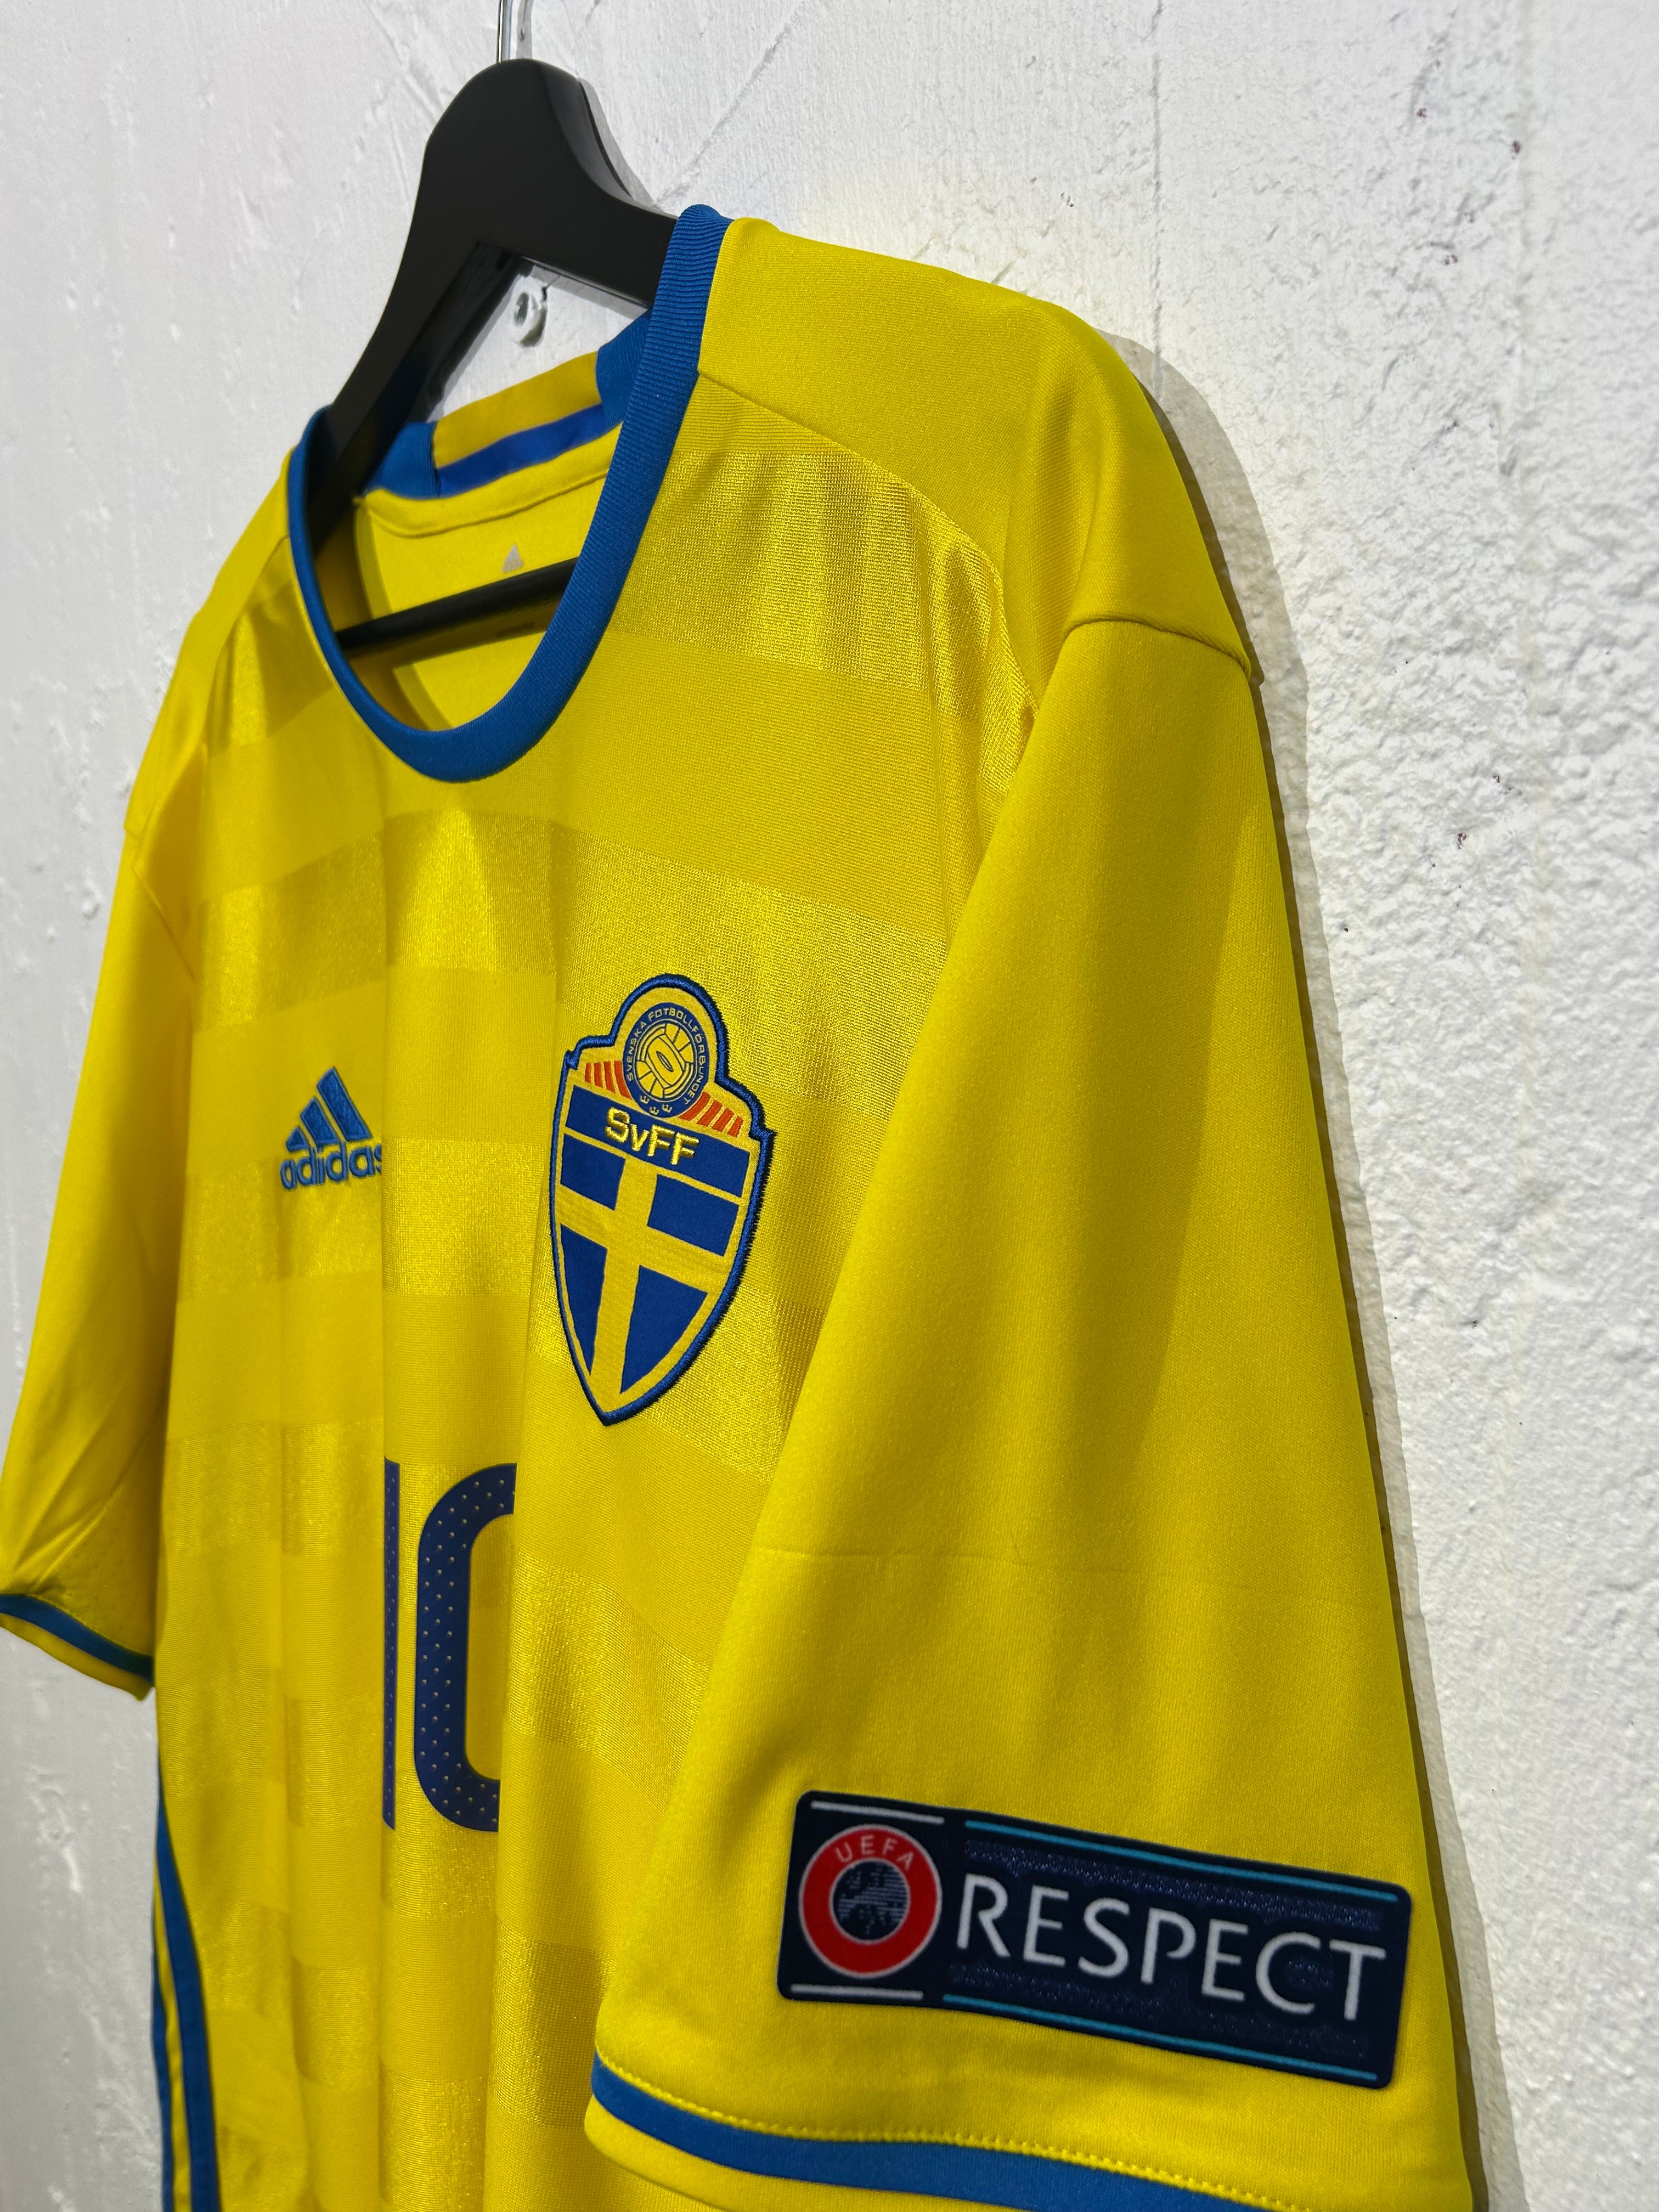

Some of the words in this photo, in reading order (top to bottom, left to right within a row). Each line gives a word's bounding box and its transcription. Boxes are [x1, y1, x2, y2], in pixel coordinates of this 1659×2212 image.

[627, 1021, 647, 1081] SVENSKA
[648, 1007, 706, 1105] FOTBOLLFÖRBUNDET
[605, 1107, 700, 1166] SvFF
[833, 1833, 915, 1871] UEFA
[956, 1874, 1386, 2022] RESPECT
